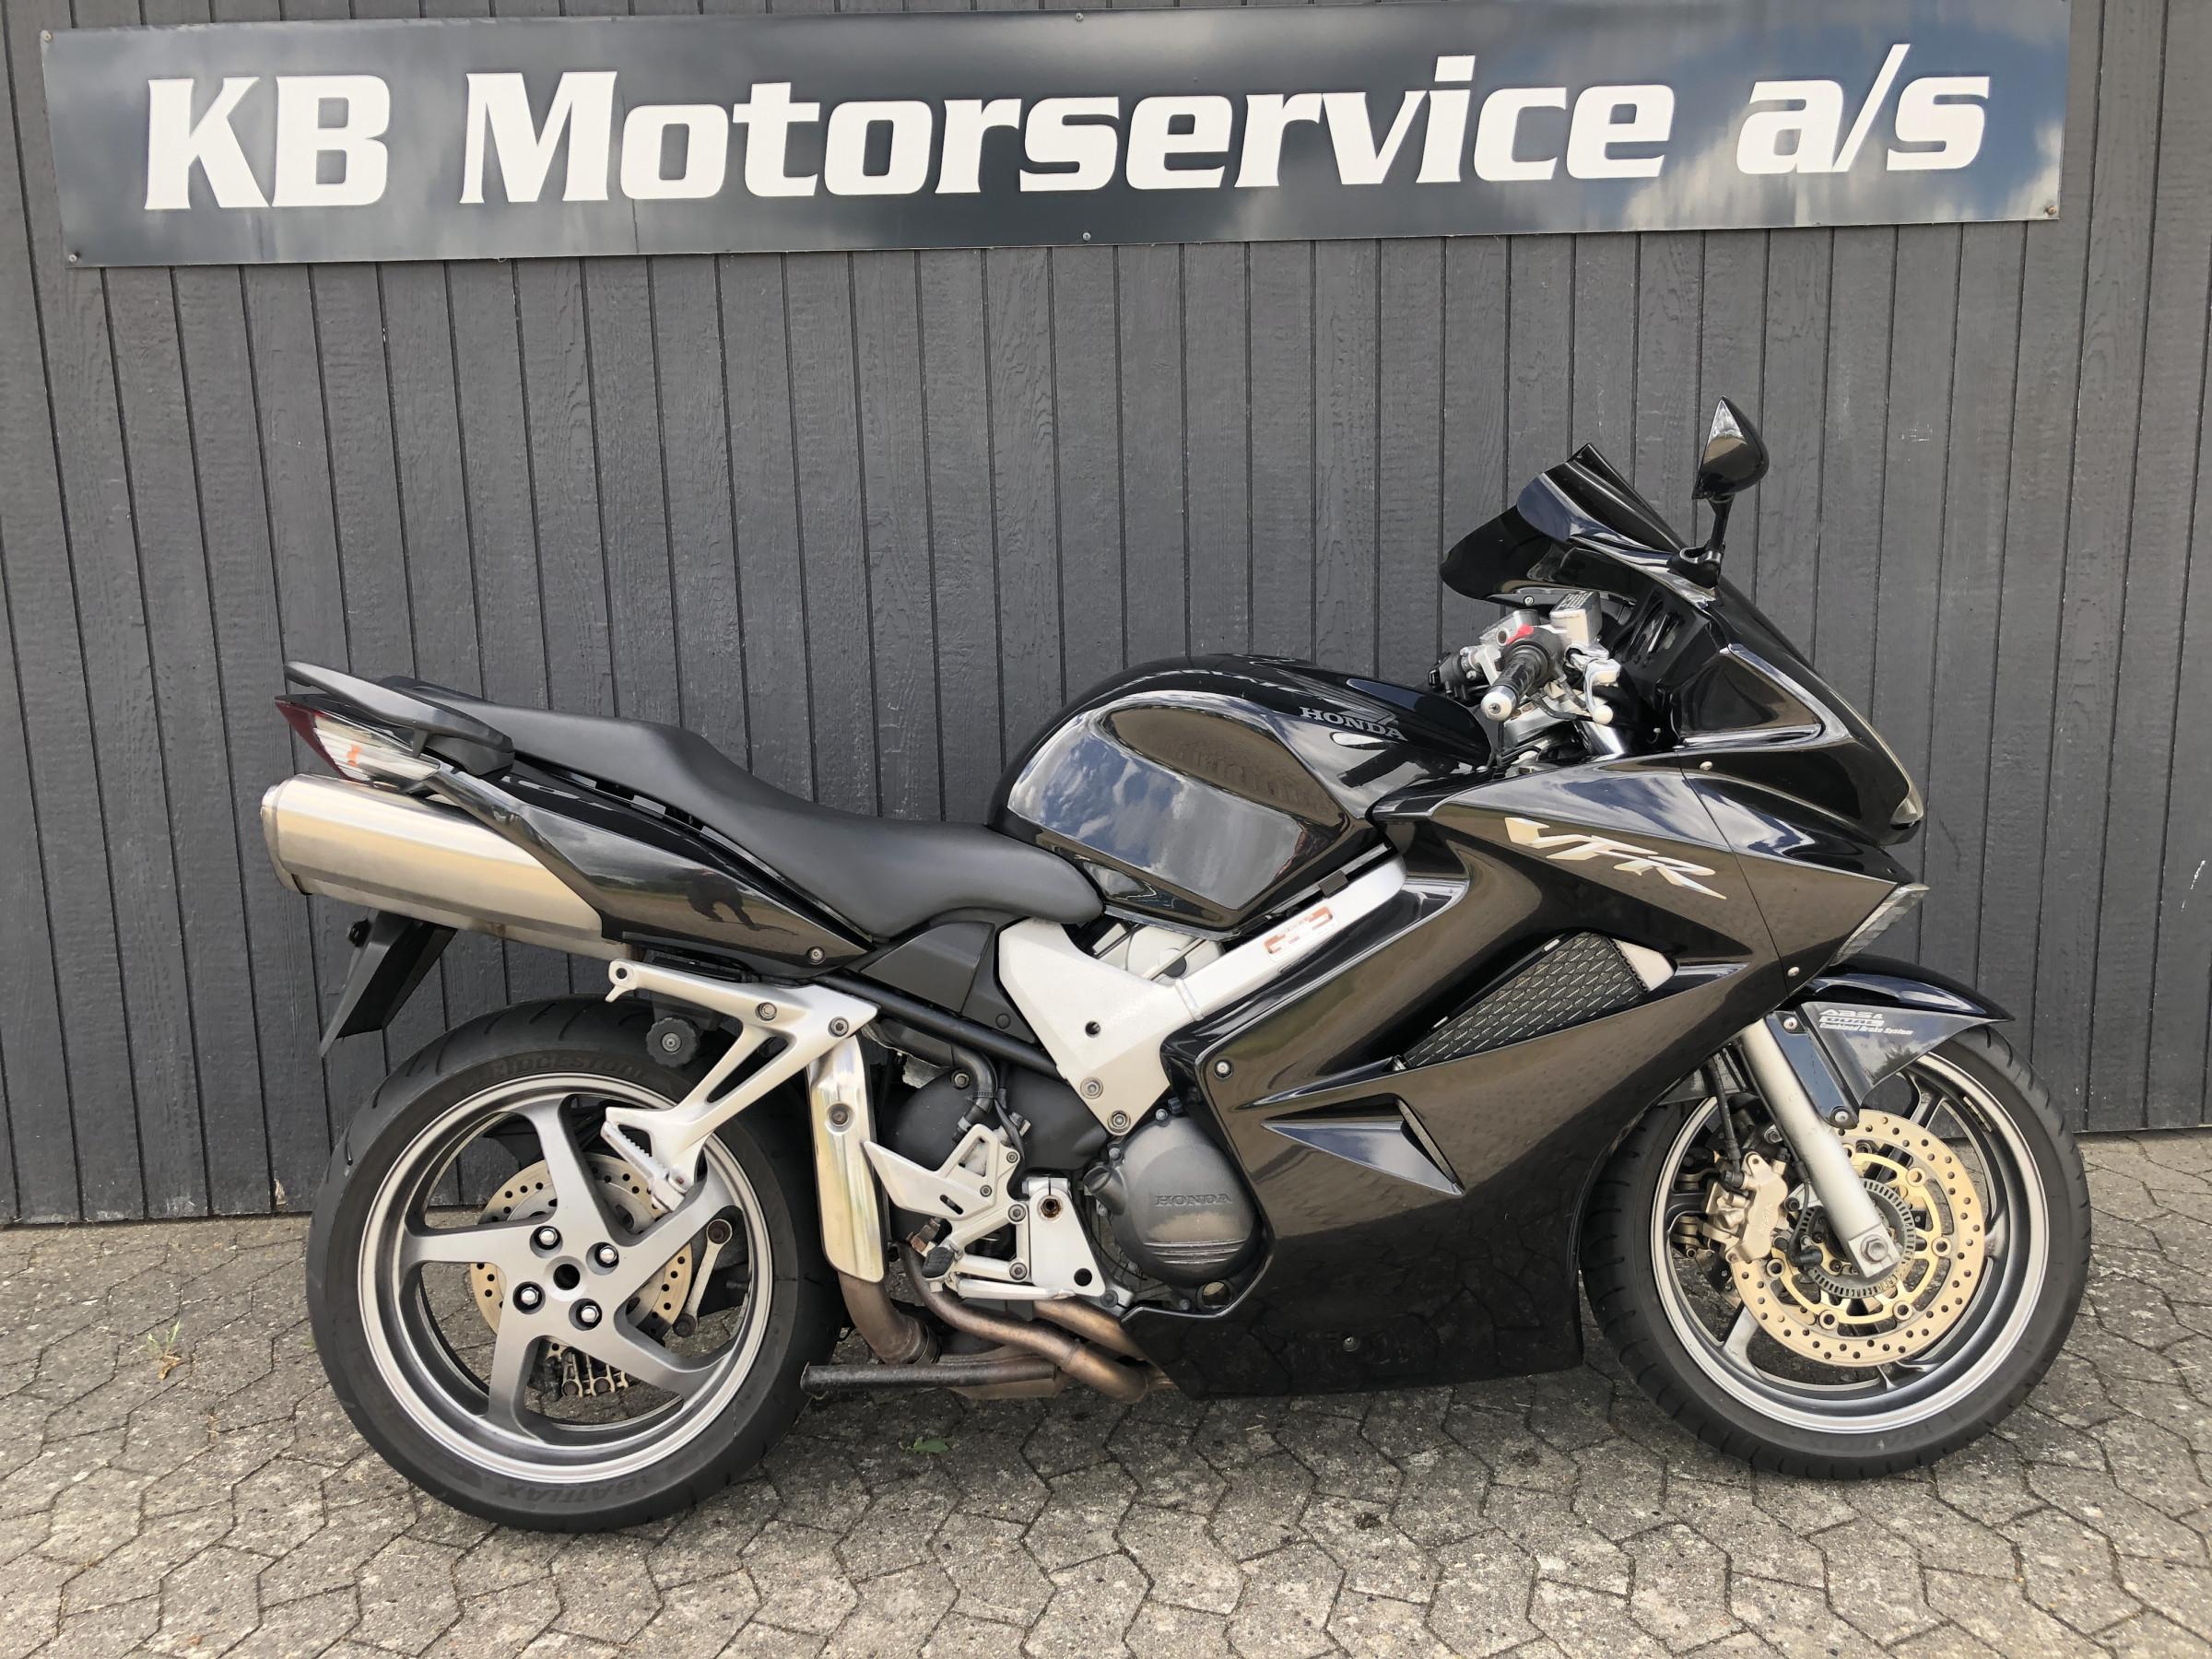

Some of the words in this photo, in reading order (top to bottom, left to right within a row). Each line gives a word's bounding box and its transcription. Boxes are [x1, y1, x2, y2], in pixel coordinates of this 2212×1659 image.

[145, 75, 390, 210] KB
[459, 54, 1676, 205] Motorservice
[1736, 43, 1990, 175] a/s
[1299, 706, 1408, 742] HONDA
[1155, 1194, 1233, 1207] HONDA
